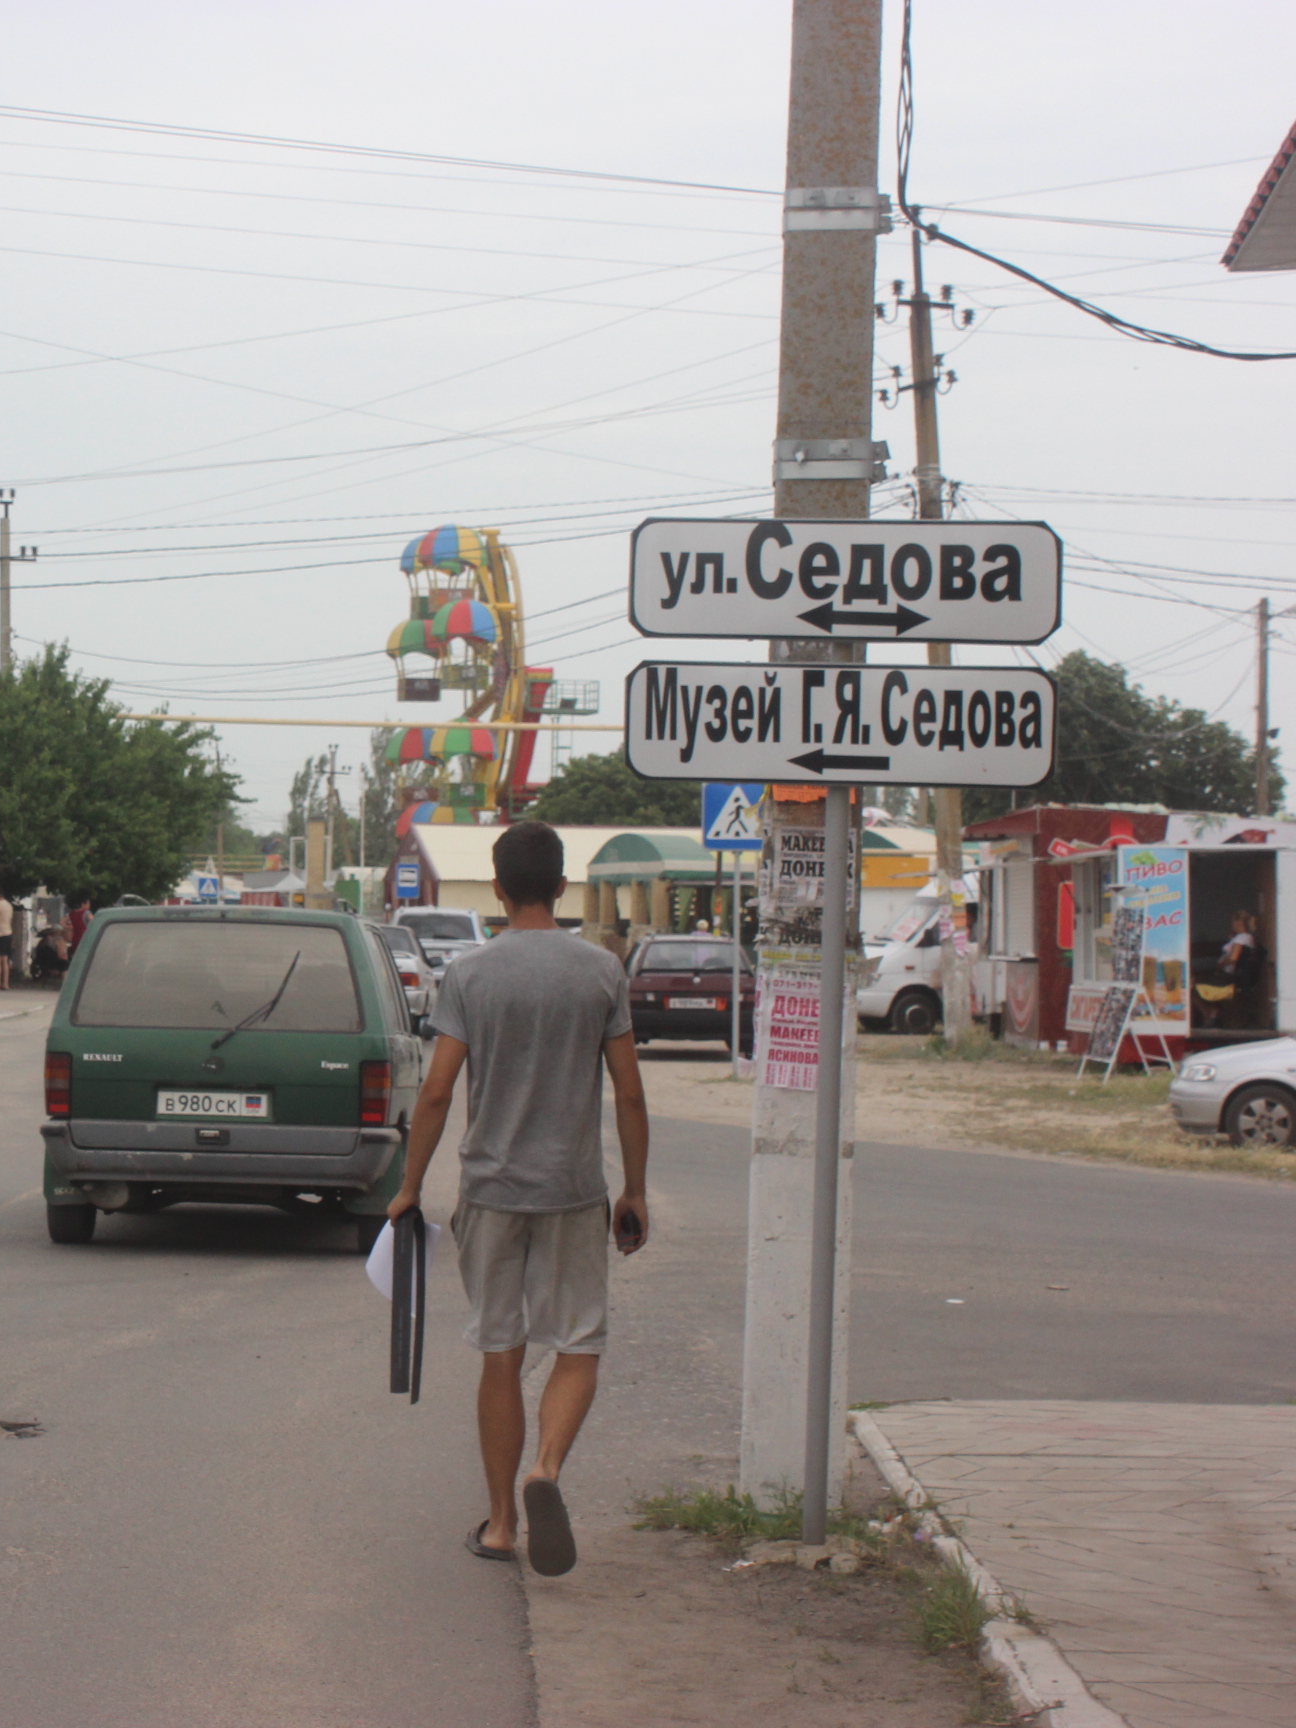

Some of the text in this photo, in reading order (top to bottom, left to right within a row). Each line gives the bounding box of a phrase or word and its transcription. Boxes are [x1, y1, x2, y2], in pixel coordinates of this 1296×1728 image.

[644, 666, 782, 764] Музей
[1126, 859, 1183, 882] ПИВО
[1144, 910, 1183, 930] ВАС
[770, 995, 821, 1018] ДОНЕ
[769, 1025, 821, 1043] МАКЕЕ
[83, 1053, 123, 1062] RENAULT
[767, 1048, 820, 1065] ЯСИНОВА
